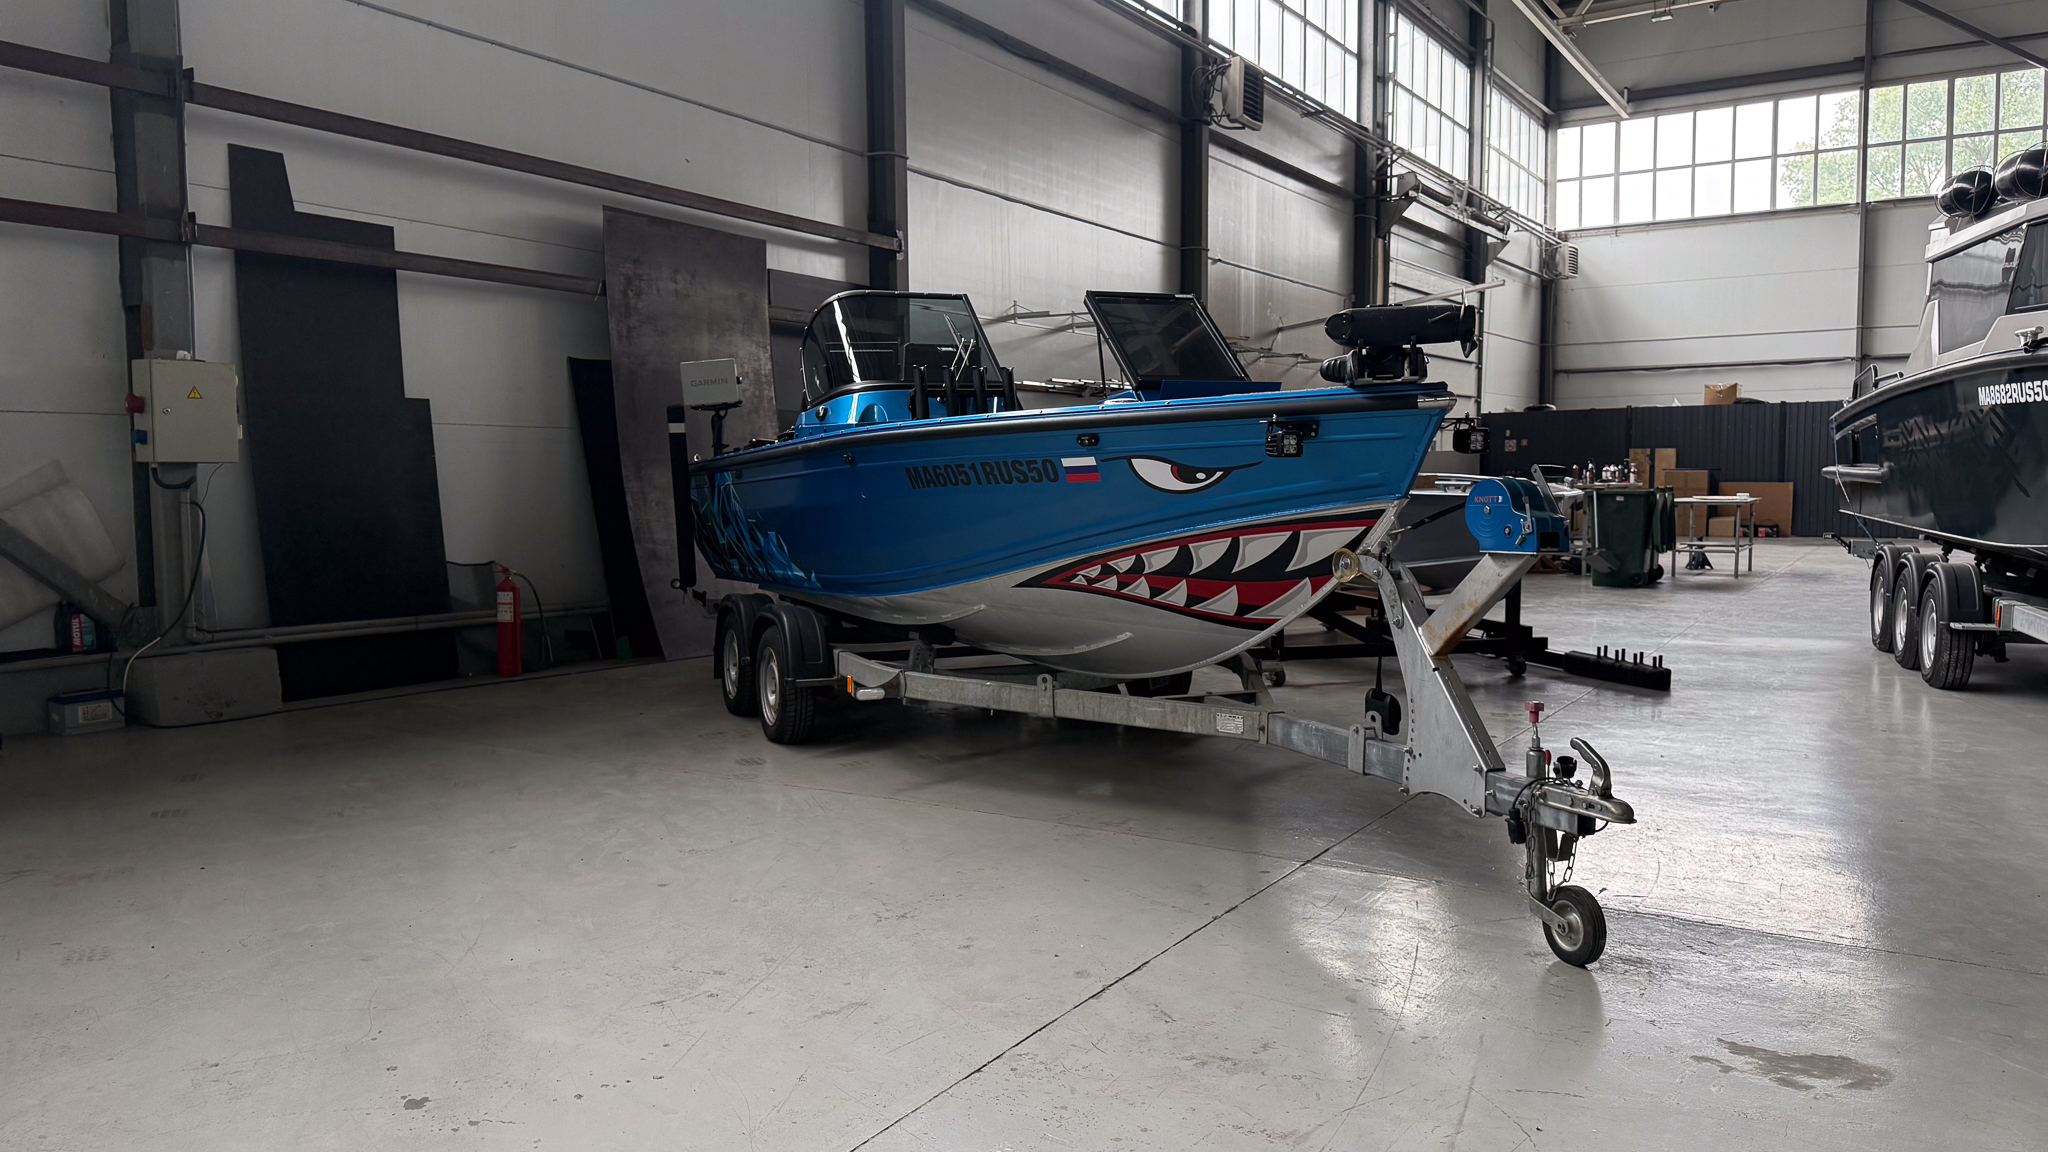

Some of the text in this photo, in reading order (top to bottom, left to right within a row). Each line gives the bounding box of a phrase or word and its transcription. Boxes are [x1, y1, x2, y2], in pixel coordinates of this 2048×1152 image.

[690, 378, 728, 387] GARMIN
[1978, 380, 2048, 406] MA8682RUS50
[904, 458, 1060, 490] MA6051RUS50
[1474, 495, 1498, 503] KNOTT
[72, 618, 81, 646] MOTUL
